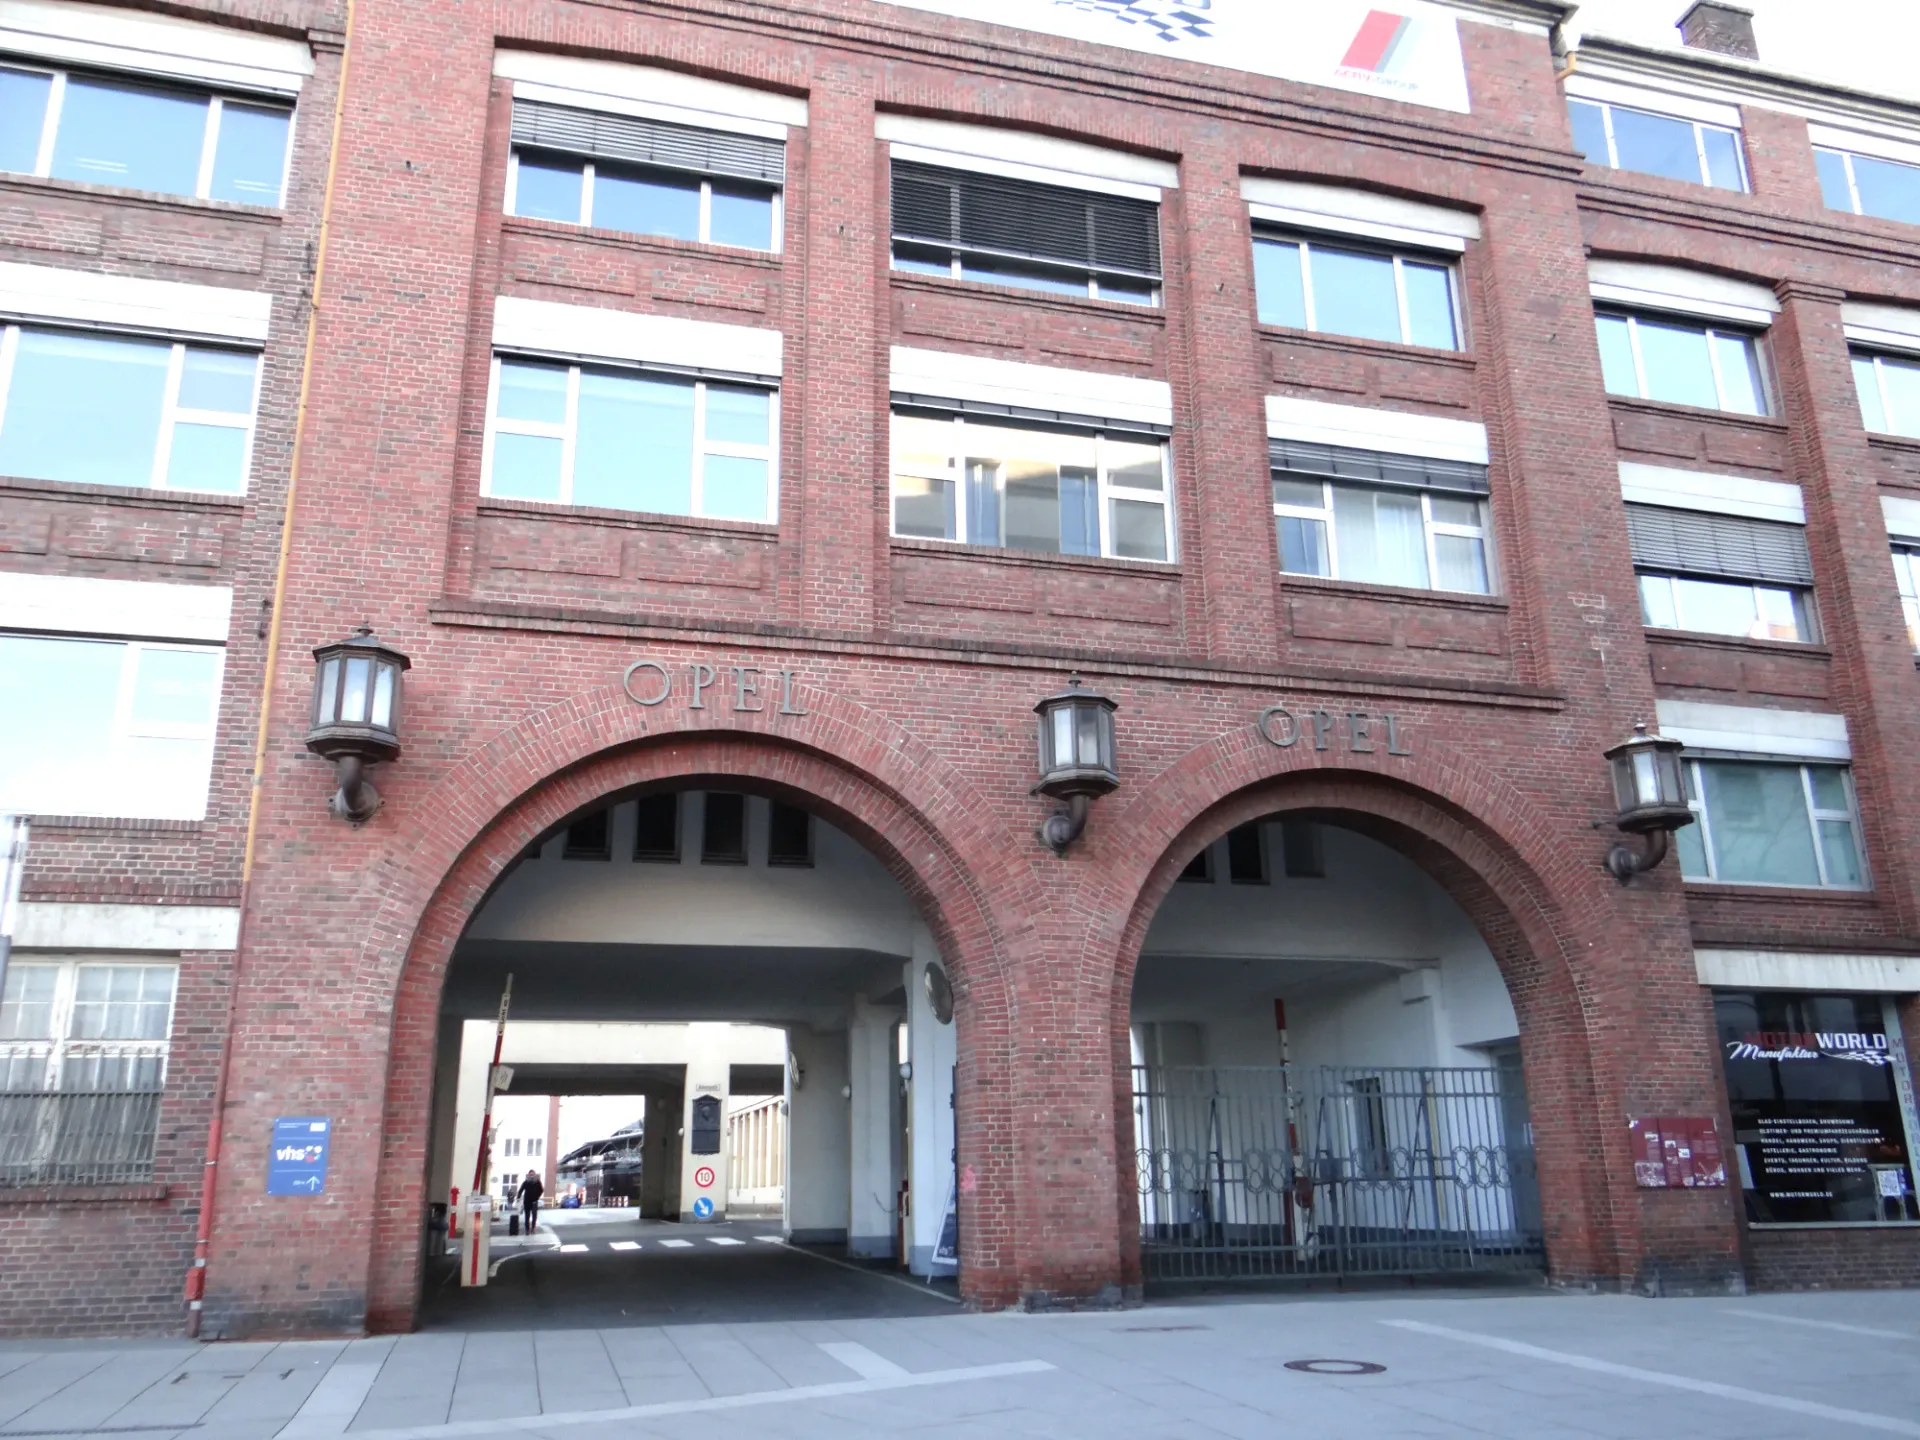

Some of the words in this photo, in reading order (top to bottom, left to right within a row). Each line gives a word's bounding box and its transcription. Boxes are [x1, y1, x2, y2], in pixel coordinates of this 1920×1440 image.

[623, 660, 809, 716] OPEL
[1258, 706, 1414, 757] OPEL
[1726, 1041, 1819, 1062] Manufaktur
[276, 1145, 305, 1161] vhs
[700, 1172, 711, 1182] 10
